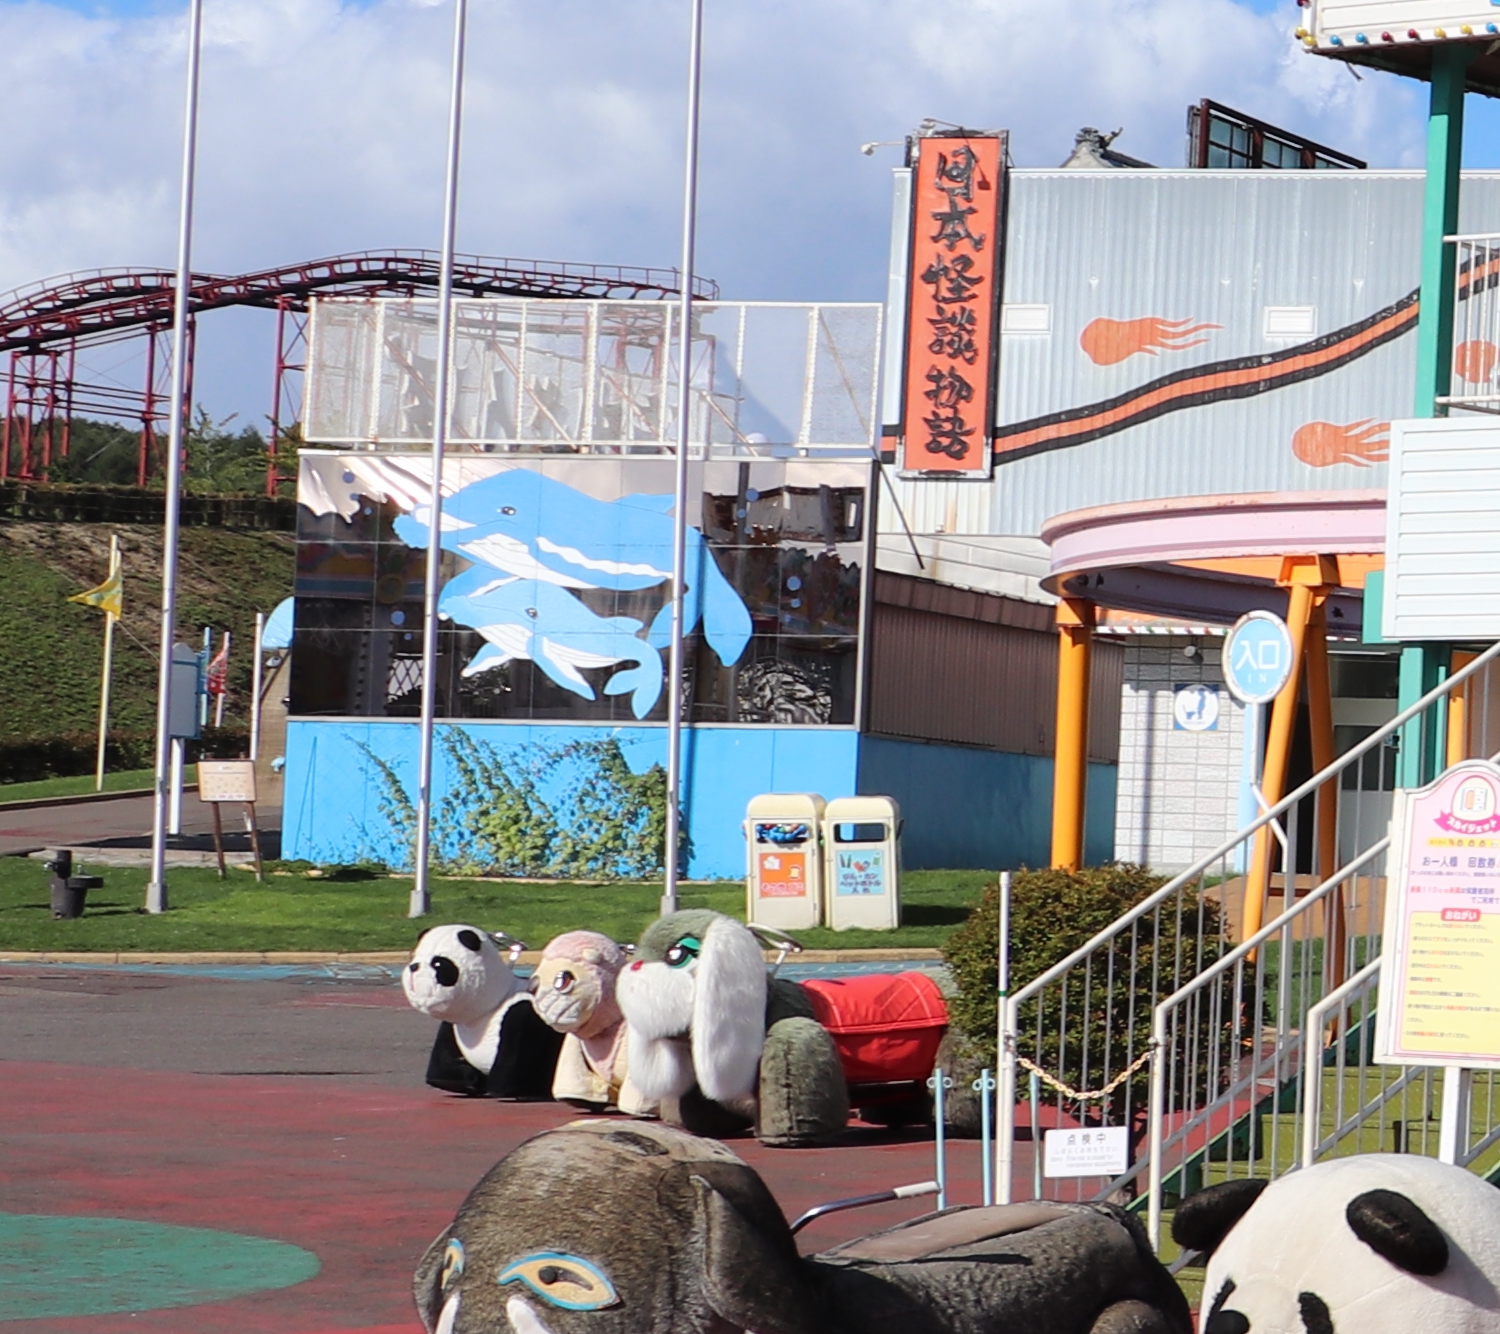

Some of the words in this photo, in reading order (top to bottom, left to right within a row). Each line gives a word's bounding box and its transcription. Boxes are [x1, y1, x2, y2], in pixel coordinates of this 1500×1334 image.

[921, 145, 984, 461] 日本怪談物語
[1235, 640, 1280, 670] 入口
[1247, 672, 1267, 684] IN
[1447, 818, 1498, 833] スカイジェット
